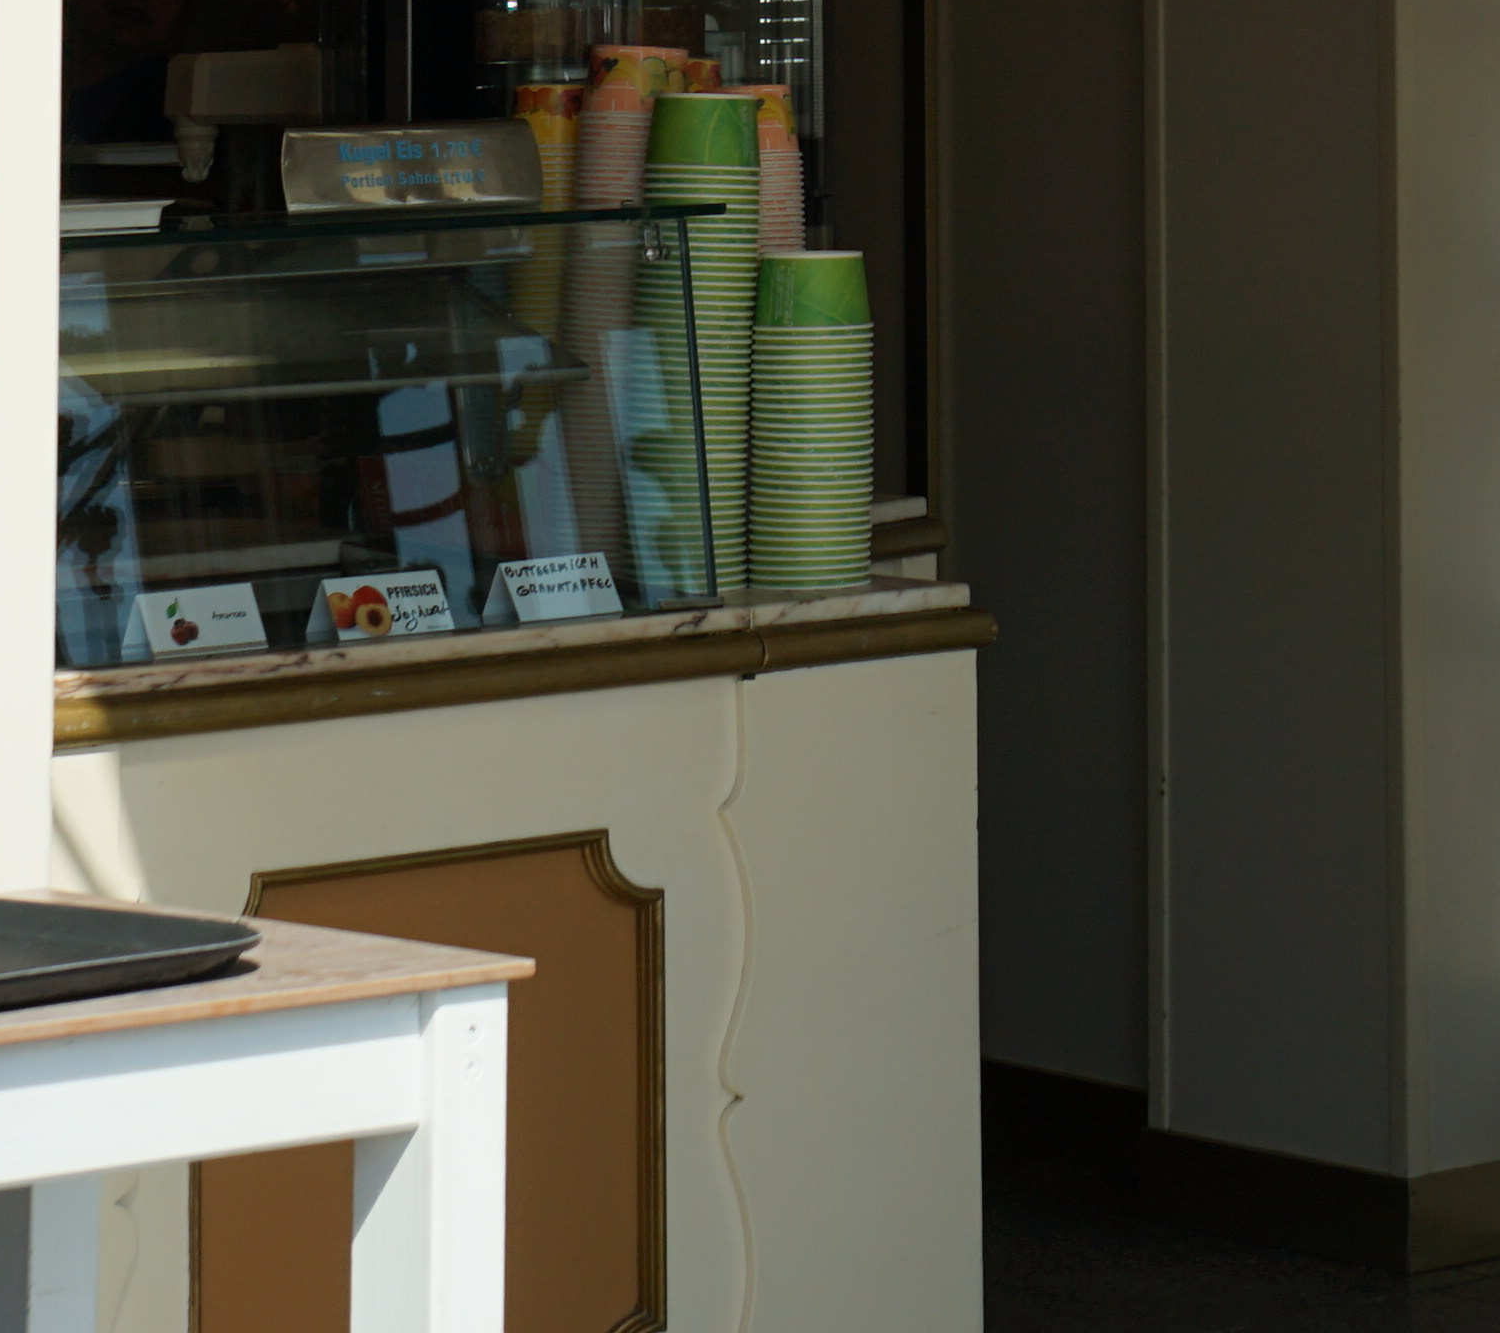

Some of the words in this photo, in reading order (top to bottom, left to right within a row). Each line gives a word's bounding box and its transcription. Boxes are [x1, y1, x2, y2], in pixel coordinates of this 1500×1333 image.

[338, 140, 392, 166] Kugel
[395, 139, 424, 161] Eis
[397, 170, 441, 186] Sahne
[386, 583, 439, 600] PFIRSICH
